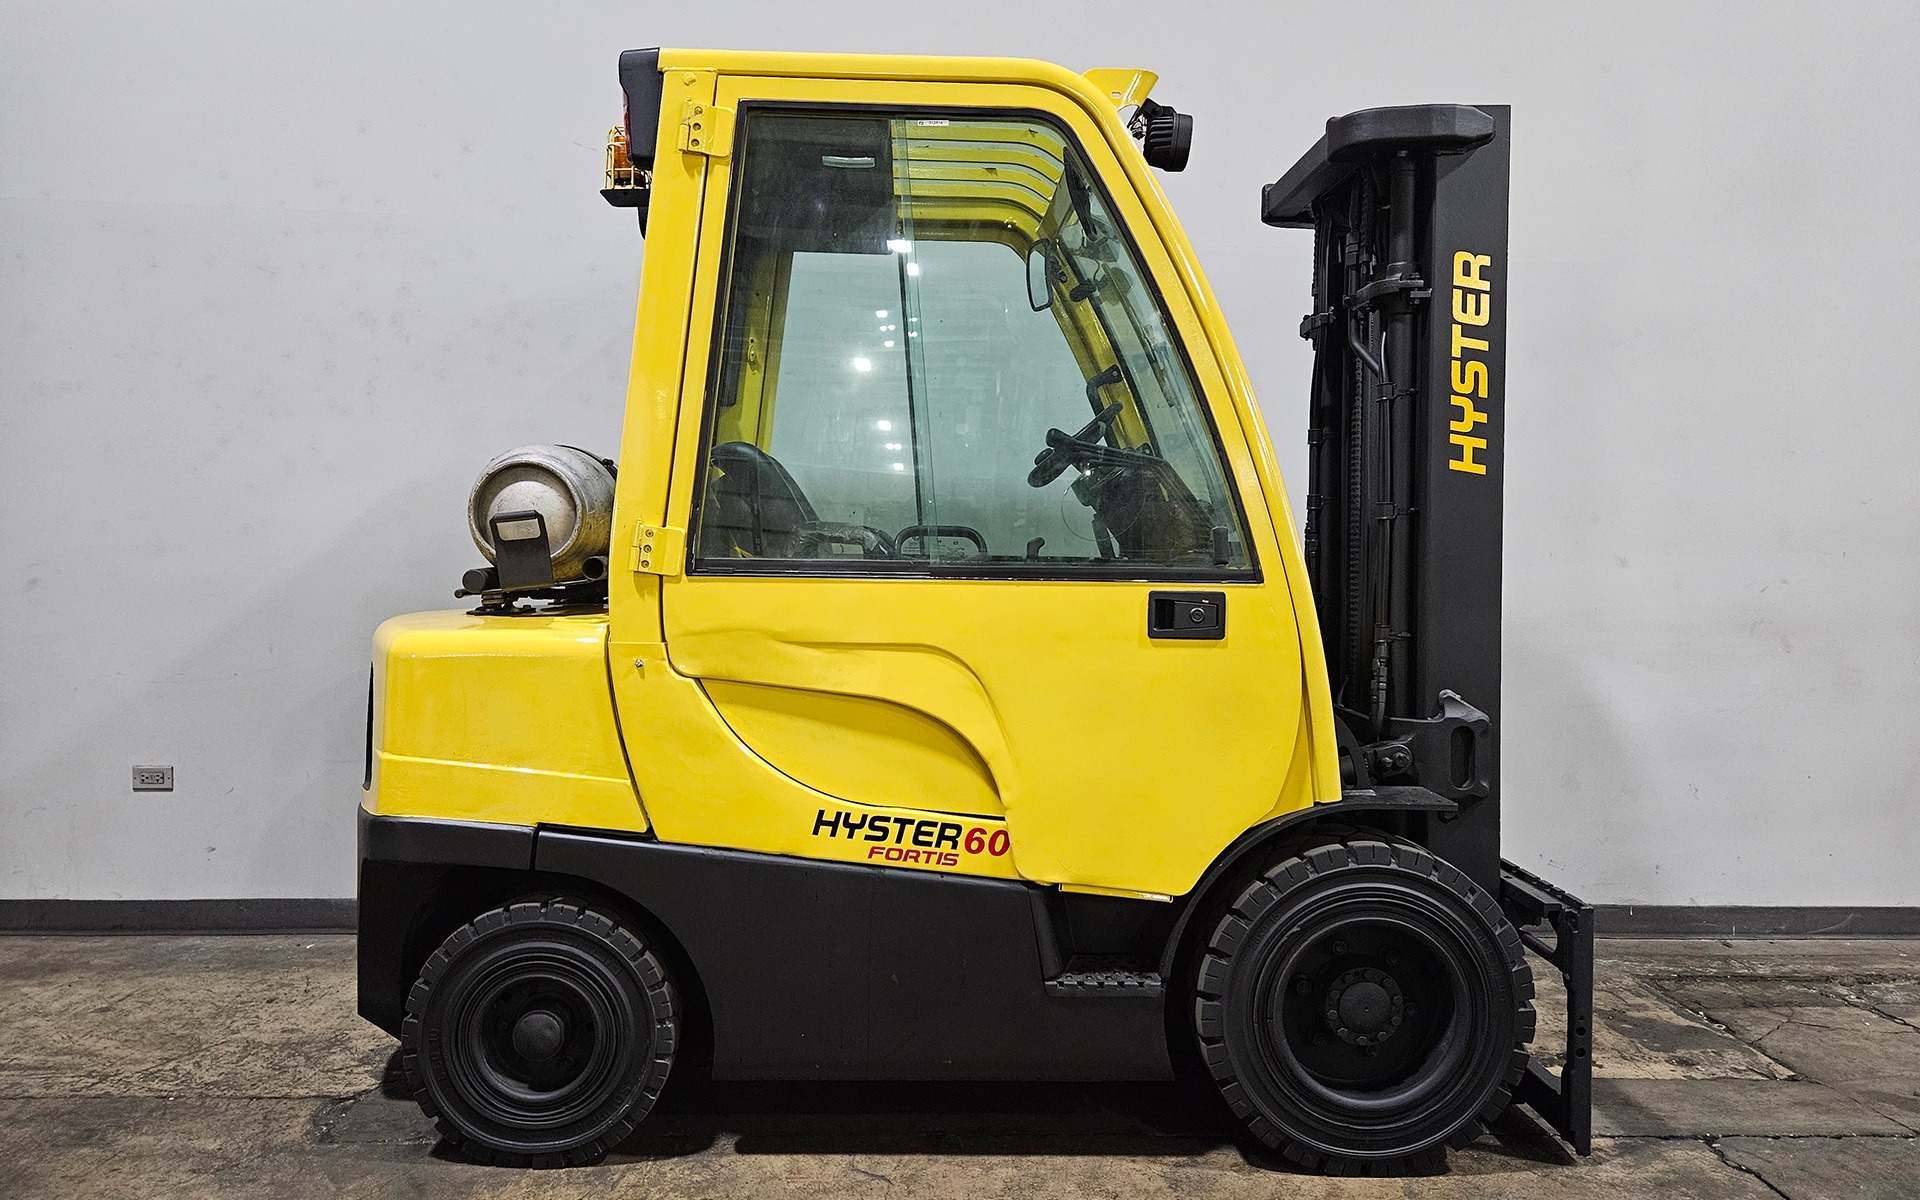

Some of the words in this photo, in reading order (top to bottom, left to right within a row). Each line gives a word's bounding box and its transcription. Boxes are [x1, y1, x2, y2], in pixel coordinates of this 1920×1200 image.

[1449, 250, 1491, 475] HYSTER
[812, 809, 963, 851] HYSTER
[964, 827, 1010, 857] 60
[867, 846, 960, 867] FORTIS
